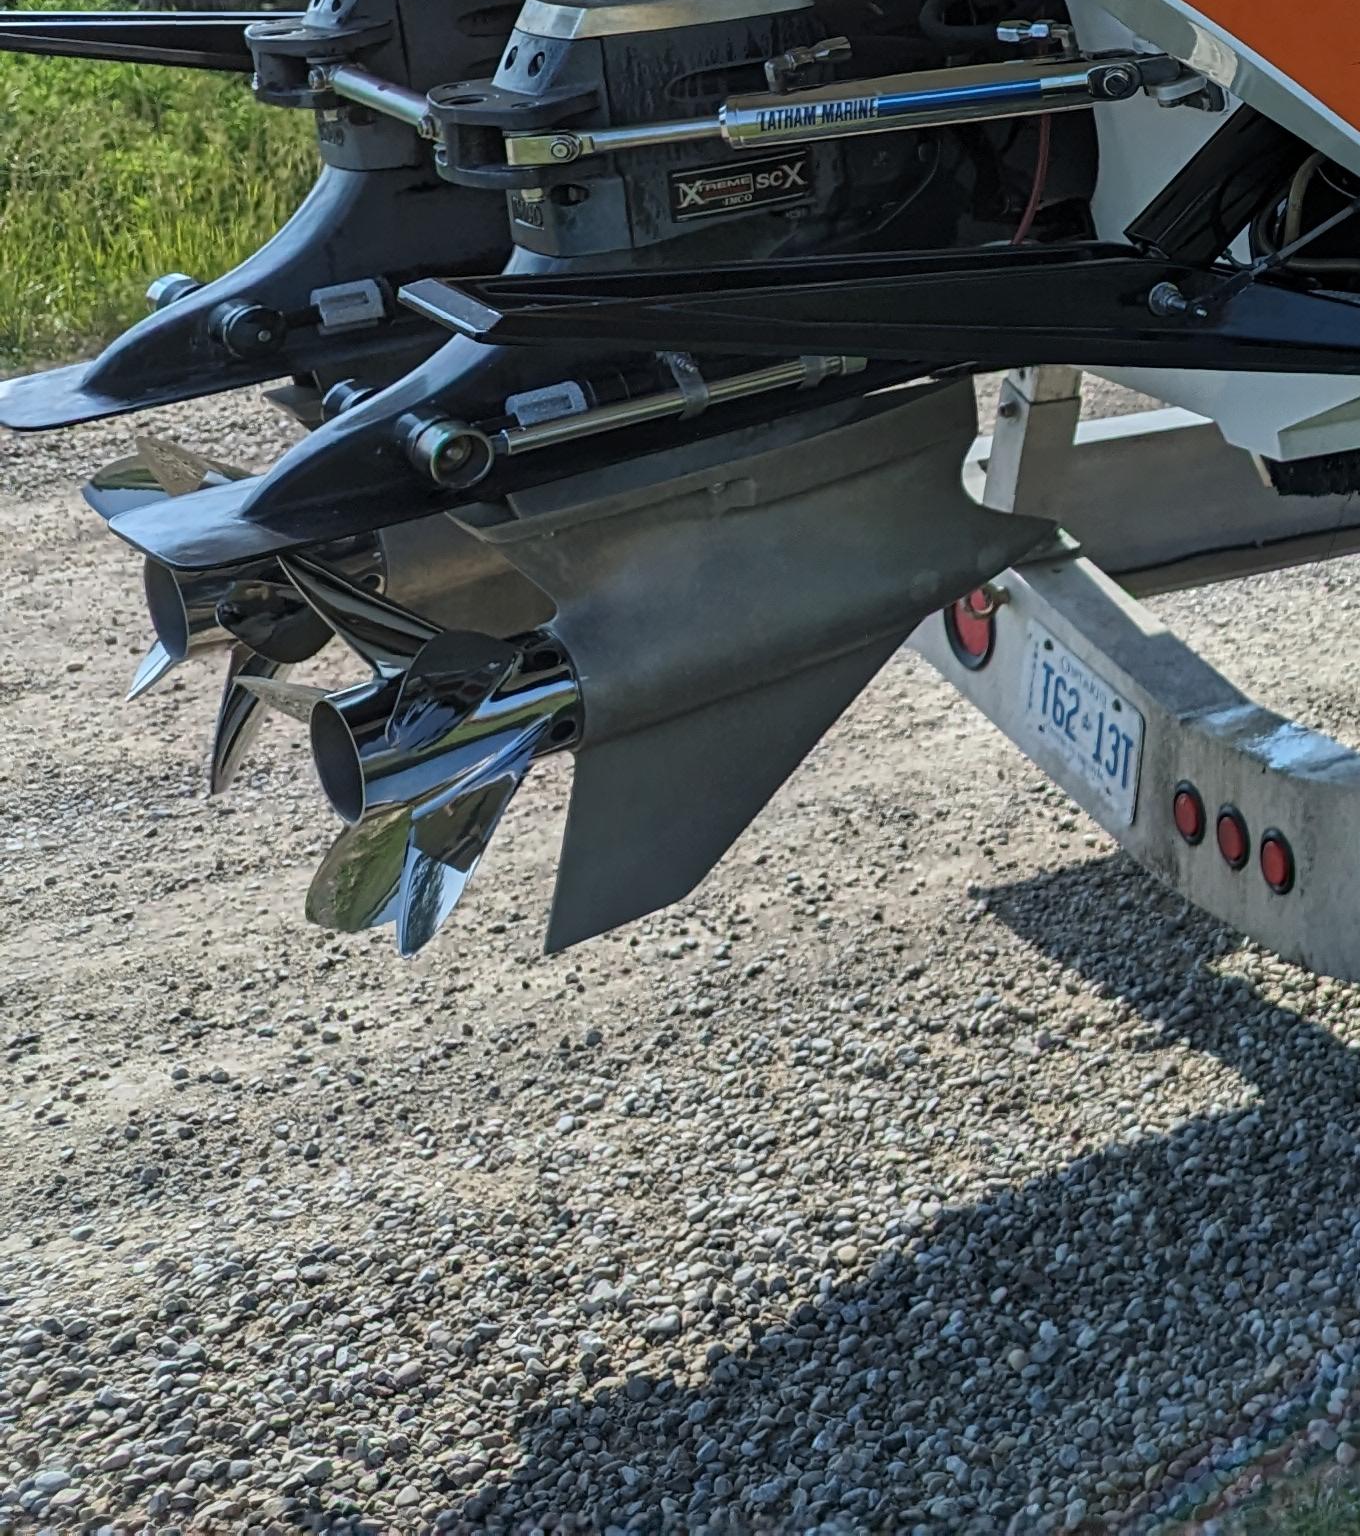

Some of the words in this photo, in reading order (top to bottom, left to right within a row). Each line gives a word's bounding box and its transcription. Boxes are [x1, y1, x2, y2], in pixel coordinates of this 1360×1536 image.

[757, 104, 818, 132] LATHAM
[820, 96, 879, 124] MARINE
[755, 161, 808, 190] SCX
